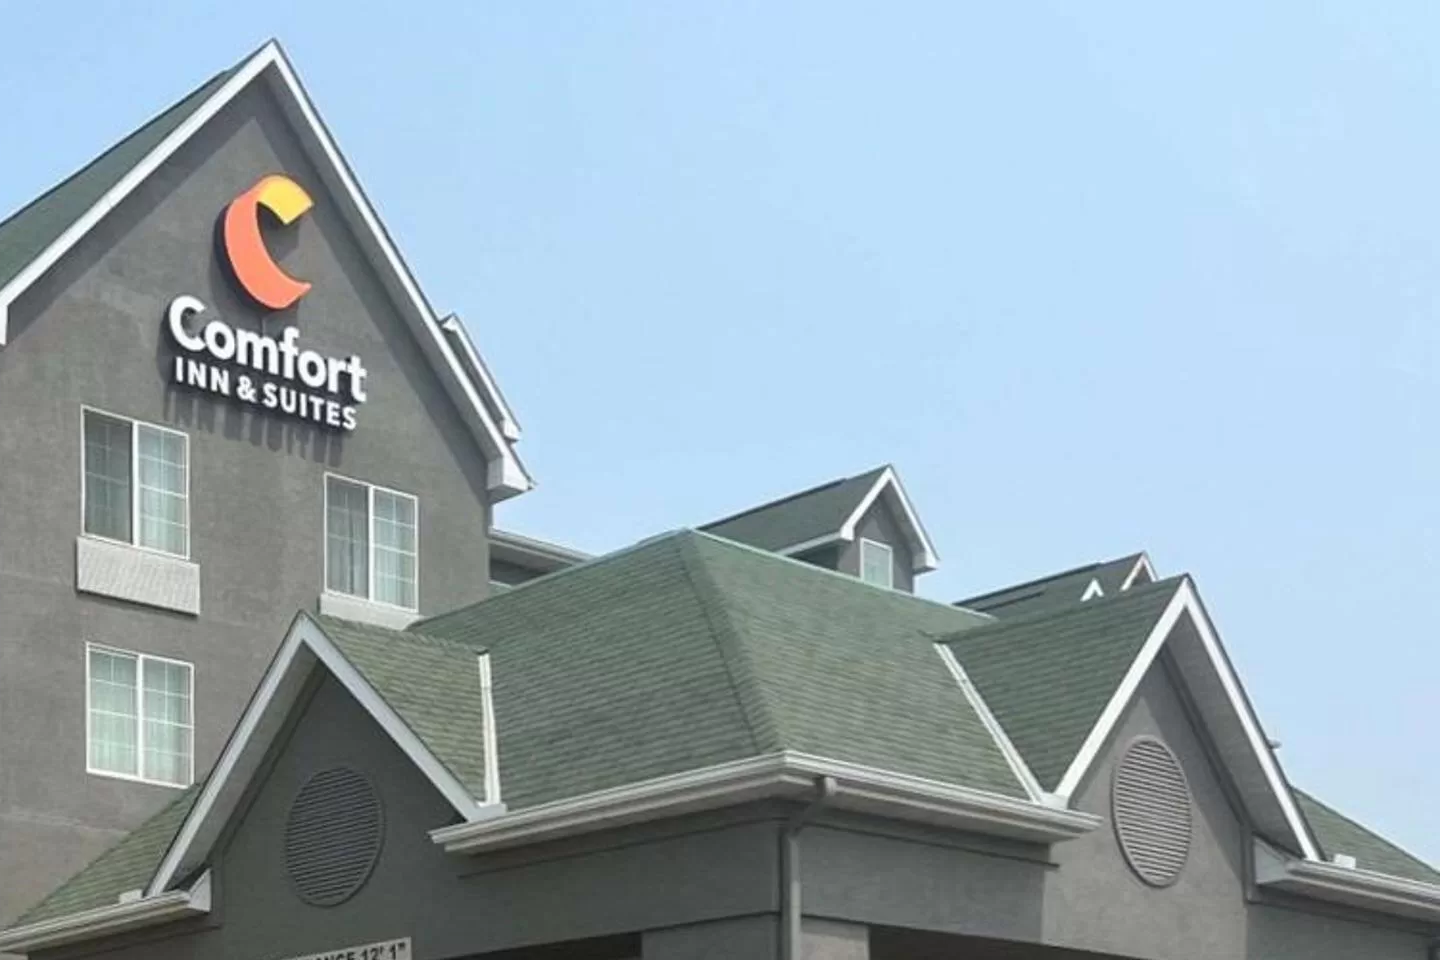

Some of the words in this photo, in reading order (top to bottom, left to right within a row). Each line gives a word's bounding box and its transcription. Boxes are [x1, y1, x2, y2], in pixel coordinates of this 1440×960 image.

[168, 295, 367, 402] Comfort
[175, 356, 230, 395] INN
[236, 375, 257, 403] &
[262, 382, 357, 430] SUITES
